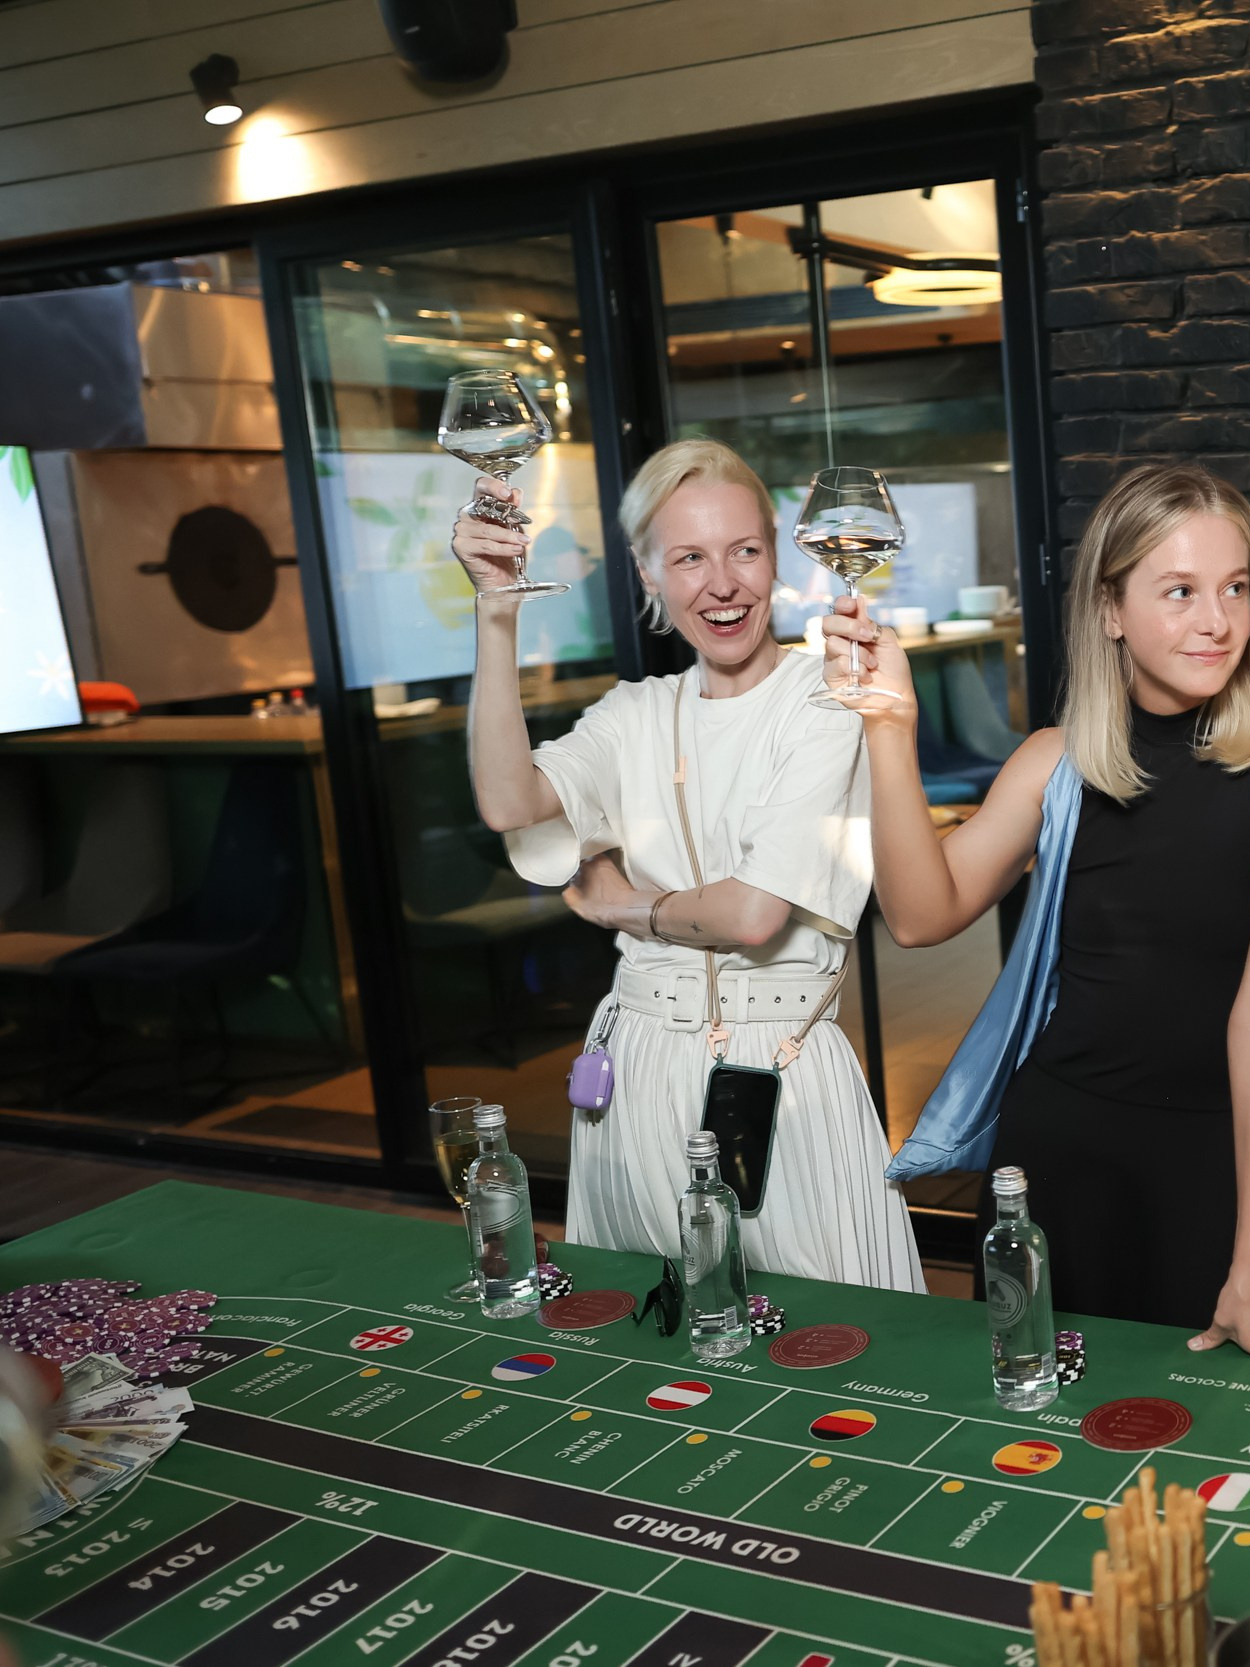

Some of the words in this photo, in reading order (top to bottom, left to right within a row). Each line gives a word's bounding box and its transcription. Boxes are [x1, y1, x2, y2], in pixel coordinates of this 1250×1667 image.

[403, 1303, 465, 1321] Georgia
[190, 1348, 237, 1363] NAT
[548, 1331, 600, 1347] Russia
[172, 1361, 205, 1375] BR
[230, 1361, 296, 1394] RAMINER
[246, 1362, 314, 1399] GEWÜRZT-
[696, 1358, 759, 1374] Austria
[1168, 1372, 1226, 1388] COLORS
[326, 1382, 397, 1418] VELTLINER
[349, 1387, 406, 1418] GRÜNER
[841, 1379, 930, 1403] Germany
[440, 1403, 510, 1444] RKATSITELI
[1037, 1412, 1082, 1428] pain
[554, 1429, 603, 1459] BLANC
[569, 1431, 623, 1465] CHENIN
[677, 1448, 743, 1494] MOSCATO
[314, 1491, 379, 1516] 12%
[803, 1476, 851, 1512] GRIGIO
[828, 1483, 869, 1514] PINOT
[613, 1513, 728, 1551] WORLD
[948, 1500, 1009, 1549] VIOGNIER
[44, 1529, 131, 1577] 2013
[127, 1542, 216, 1591] 2014
[731, 1538, 801, 1565] OLD
[198, 1560, 285, 1612] 2015
[272, 1578, 359, 1631] 2016
[354, 1599, 434, 1655] 2017
